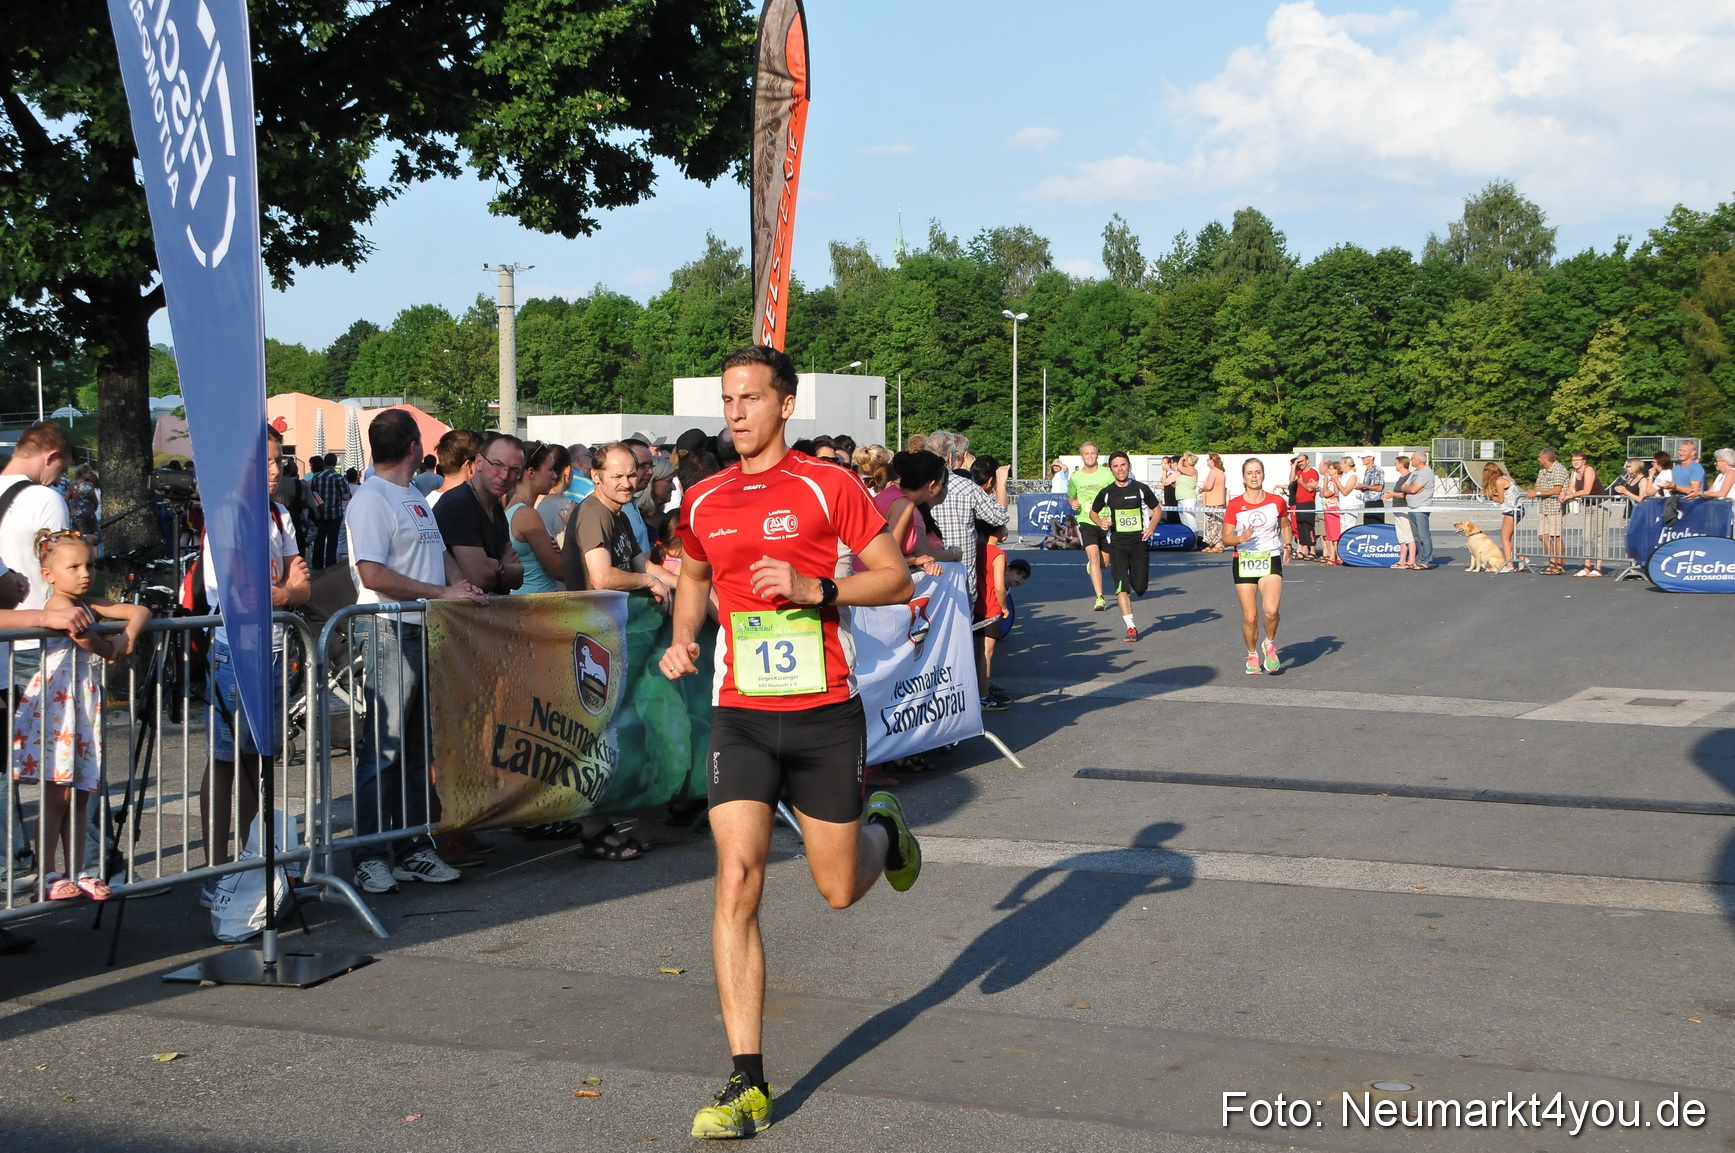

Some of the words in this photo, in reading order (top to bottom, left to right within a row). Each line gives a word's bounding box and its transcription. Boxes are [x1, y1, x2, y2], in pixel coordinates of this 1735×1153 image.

[1119, 516, 1138, 527] 963
[1357, 542, 1401, 553] Fische
[1240, 559, 1270, 571] 1026
[1676, 560, 1735, 574] Fische
[755, 640, 797, 674] 13
[881, 686, 966, 737] Lammsbräu
